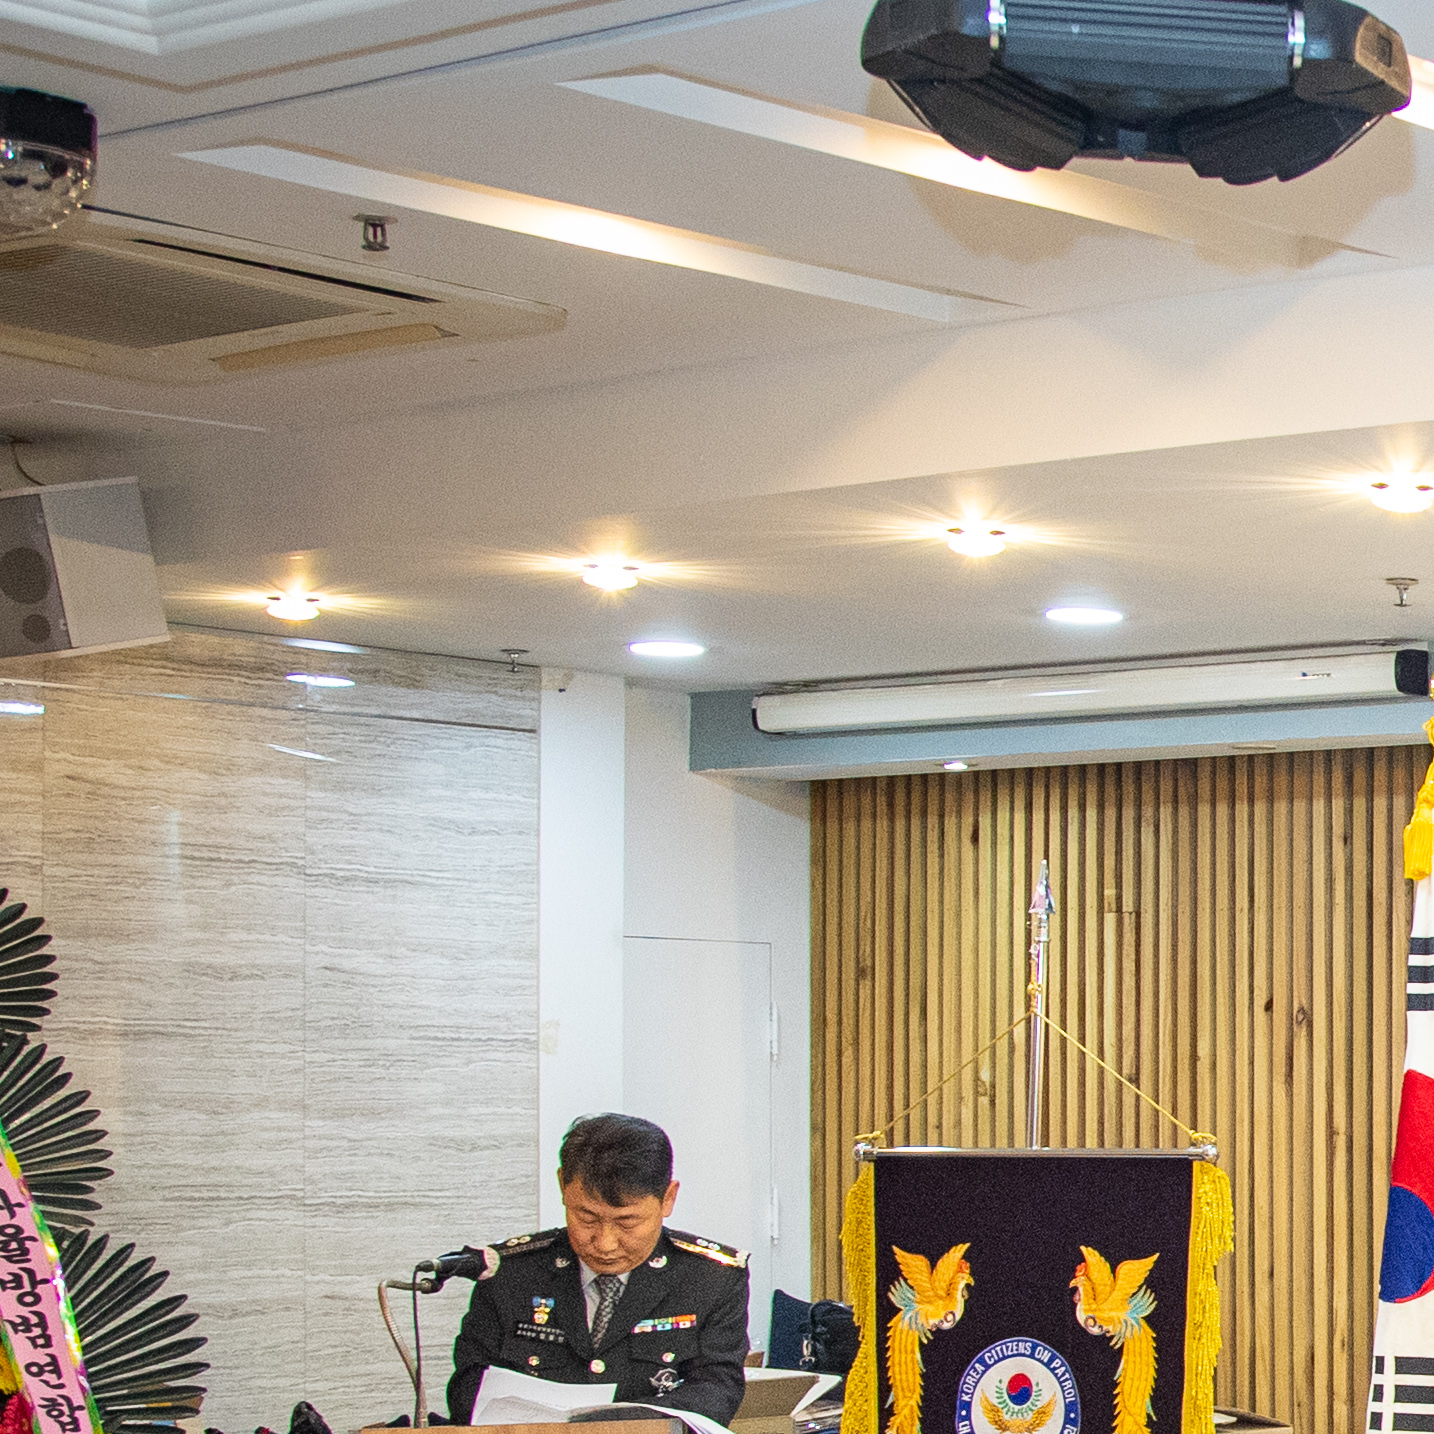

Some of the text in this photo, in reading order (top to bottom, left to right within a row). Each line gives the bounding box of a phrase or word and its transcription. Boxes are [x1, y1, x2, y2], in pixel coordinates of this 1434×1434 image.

[961, 1341, 1076, 1403] KOREA CITIZENS ON PATROL
